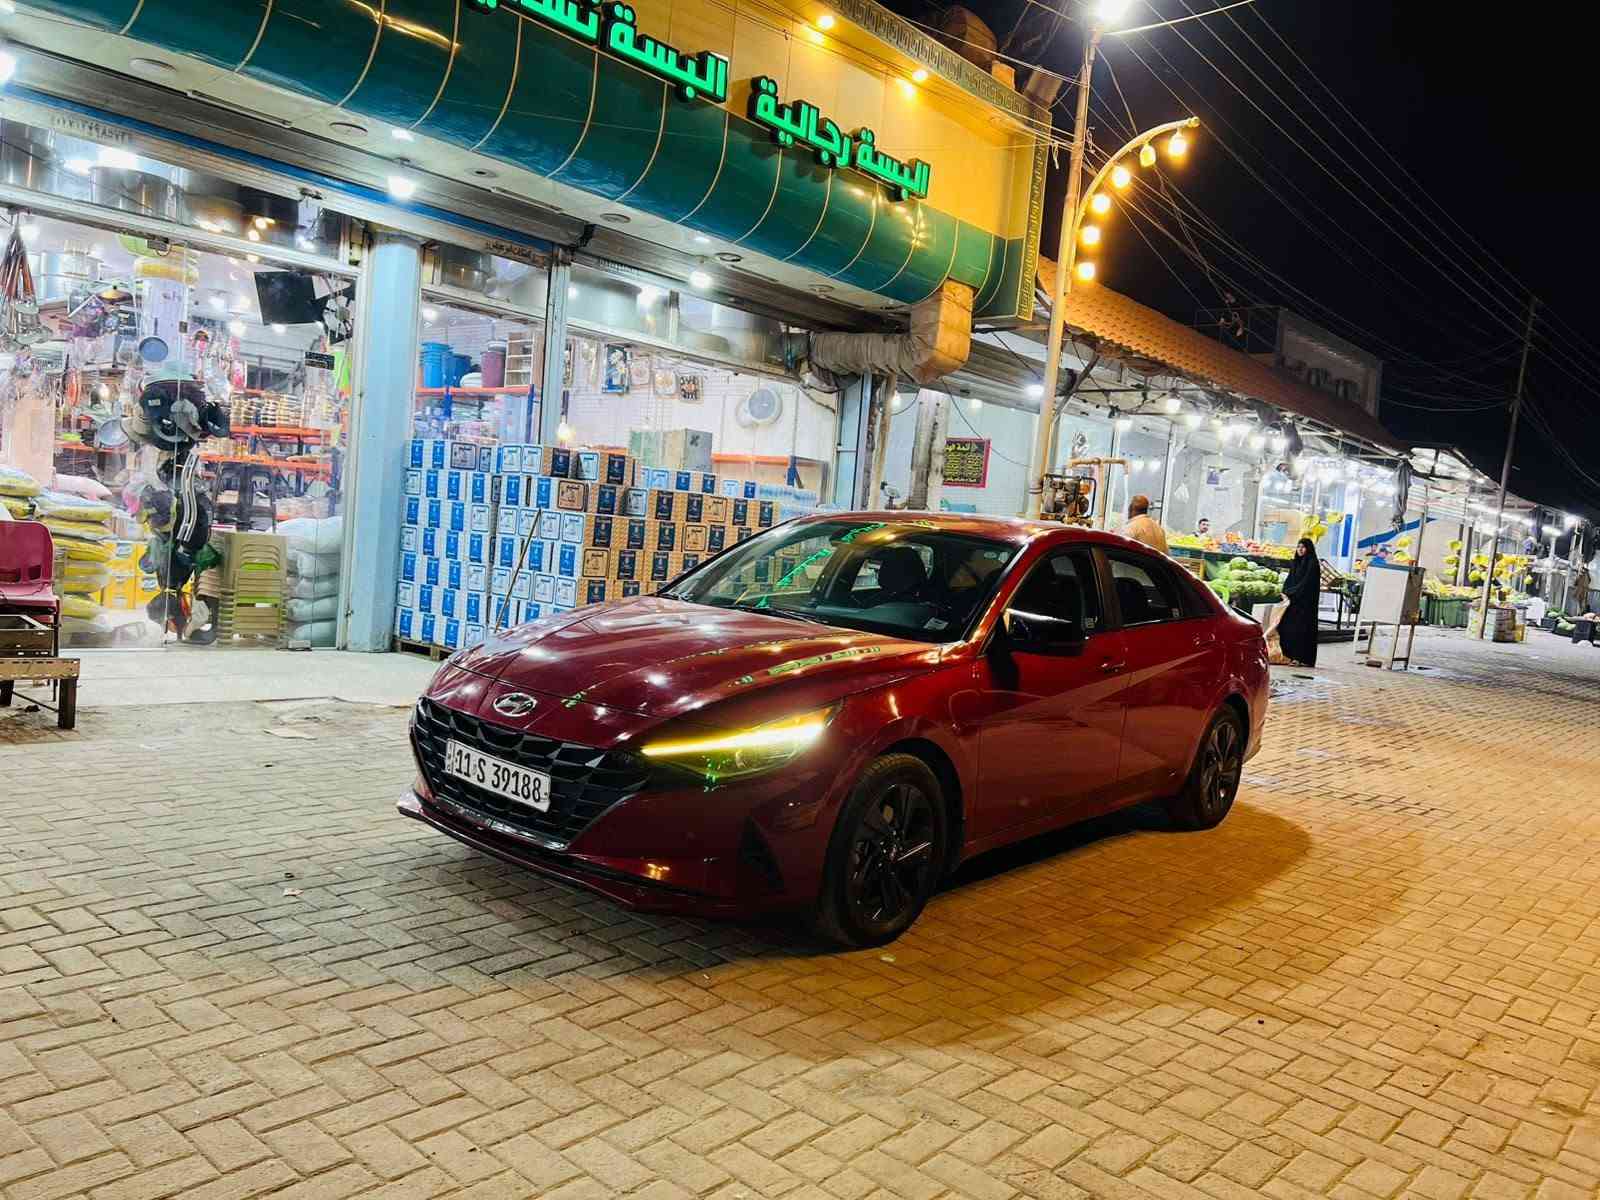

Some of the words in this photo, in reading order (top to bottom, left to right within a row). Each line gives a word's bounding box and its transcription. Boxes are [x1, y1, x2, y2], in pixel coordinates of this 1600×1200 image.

[609, 4, 727, 99] البسة
[756, 78, 851, 168] رجالية
[856, 130, 930, 199] البسة
[455, 749, 471, 778] 11
[476, 757, 487, 783] S
[491, 762, 542, 803] 39188
